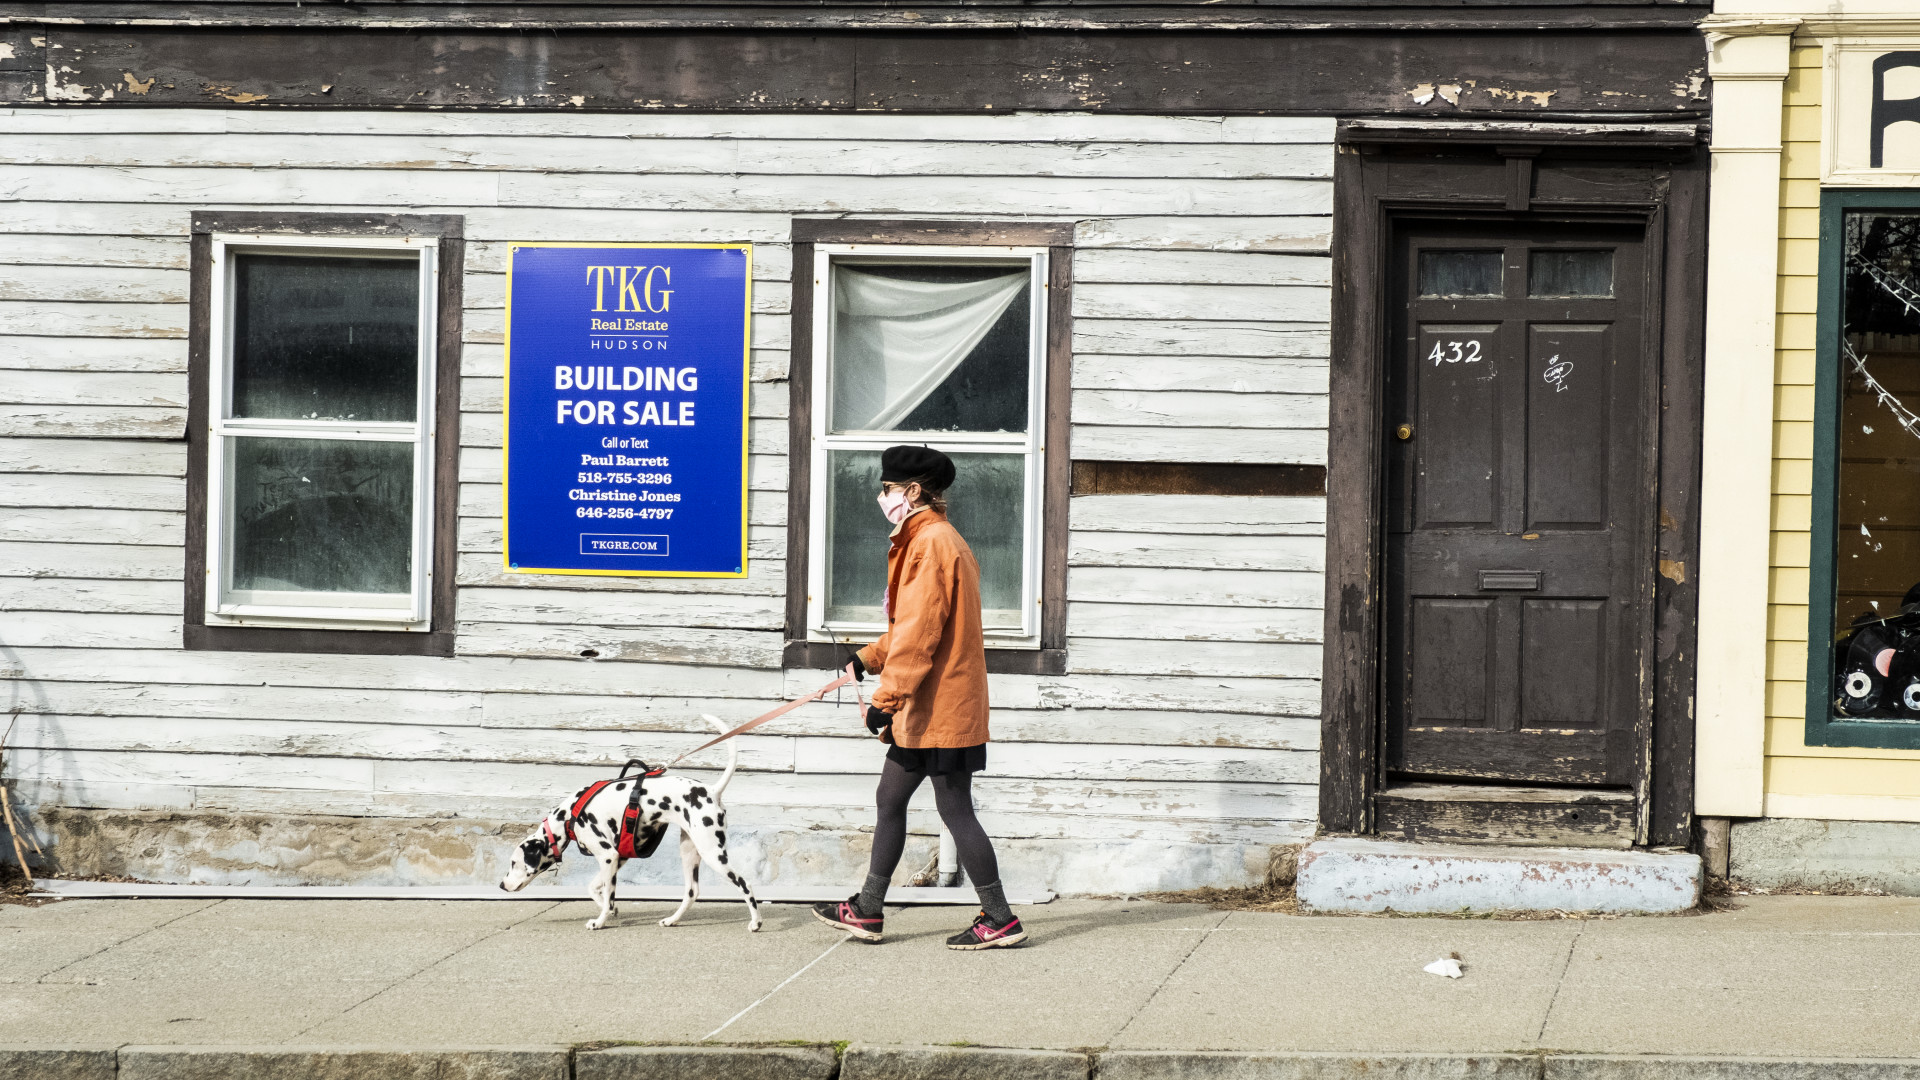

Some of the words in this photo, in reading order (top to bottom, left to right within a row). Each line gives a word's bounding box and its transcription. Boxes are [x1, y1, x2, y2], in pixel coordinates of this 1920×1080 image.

[586, 265, 674, 313] TKG
[591, 318, 622, 330] Real
[624, 319, 669, 331] Estate
[591, 340, 667, 350] HUDSON
[1428, 340, 1482, 366] 432
[555, 366, 698, 391] BUILDING
[557, 400, 615, 425] FOR
[623, 401, 695, 426] SALE
[601, 436, 618, 449] Call
[619, 439, 630, 449] or
[630, 437, 649, 449] Text
[581, 454, 614, 467] Paul
[615, 455, 669, 467] Barrett
[577, 472, 672, 485] 518-755-3296
[568, 489, 636, 502] Christine
[638, 490, 681, 503] Jones
[576, 507, 674, 520] 646-256-4797
[591, 540, 658, 551] TKGRE.COM
